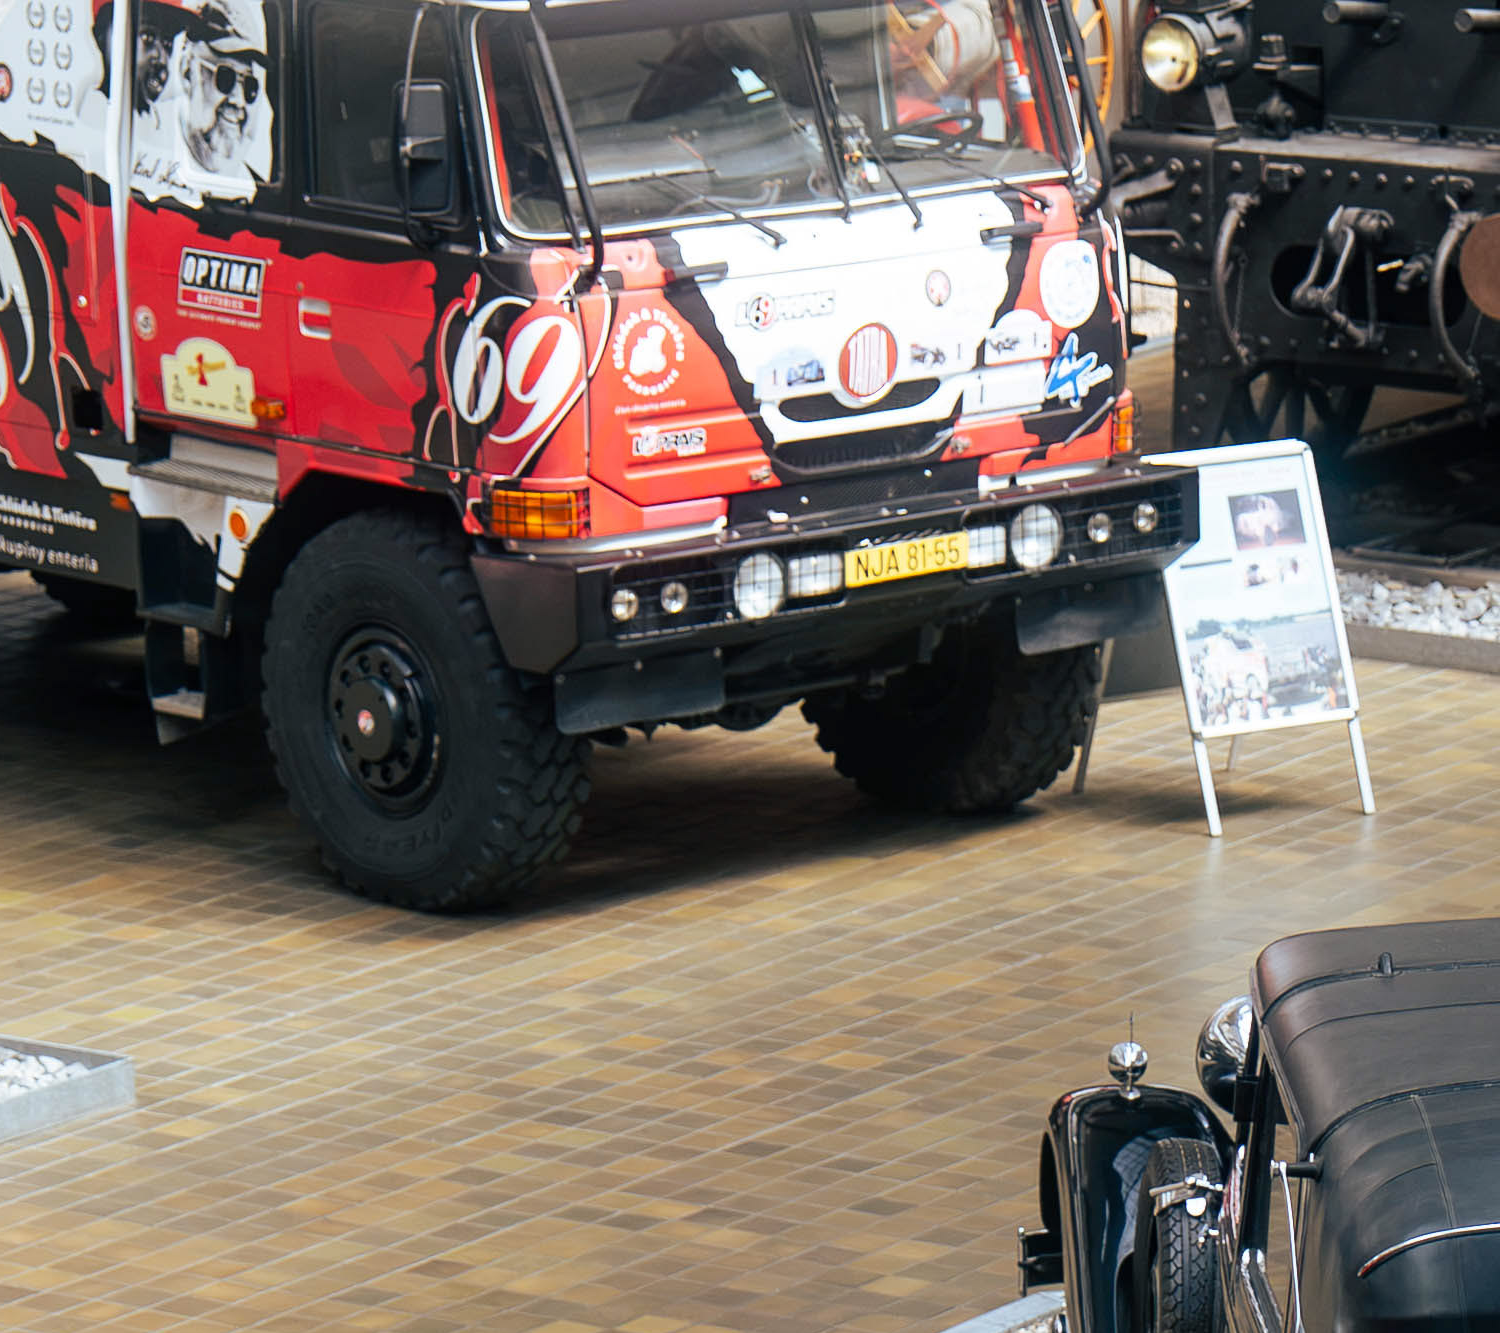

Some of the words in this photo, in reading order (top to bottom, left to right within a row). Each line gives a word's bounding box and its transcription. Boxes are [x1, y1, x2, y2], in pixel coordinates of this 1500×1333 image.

[182, 255, 260, 295] OPTIMA
[453, 296, 581, 444] 69
[47, 550, 99, 574] enteria
[856, 548, 900, 580] NJA
[907, 536, 960, 572] 81-55
